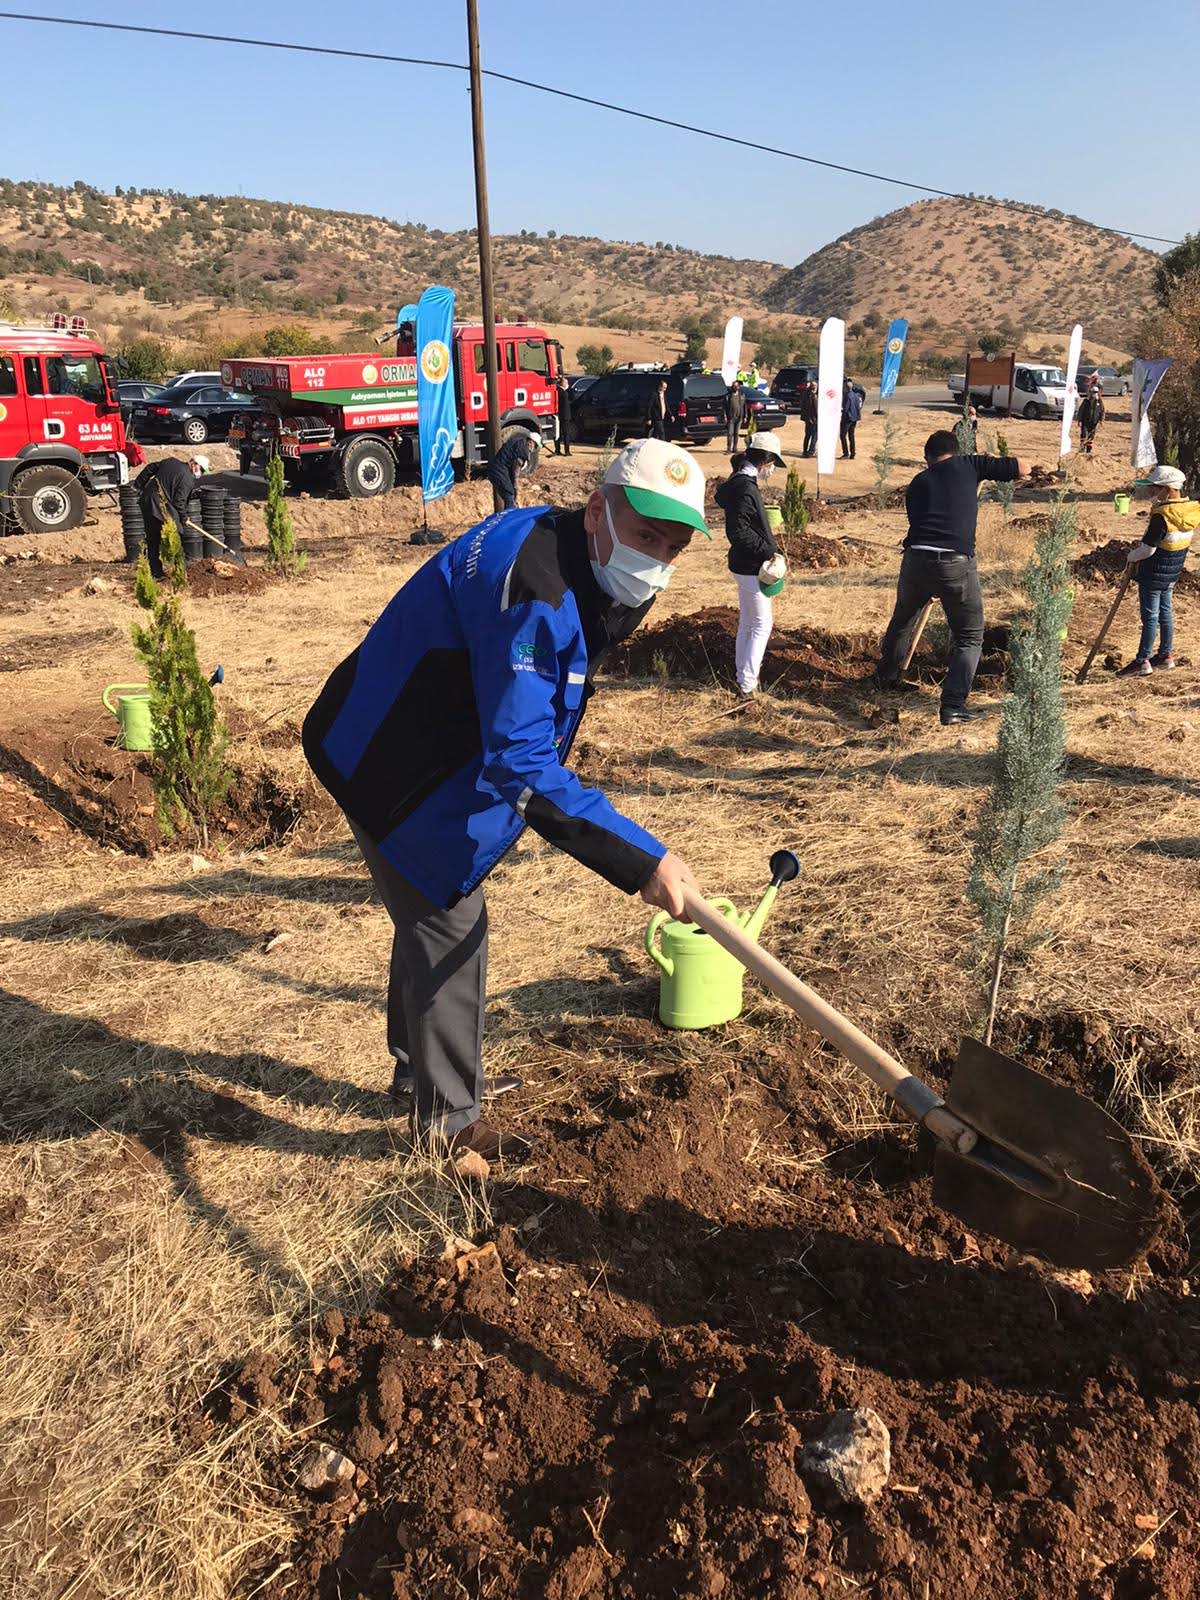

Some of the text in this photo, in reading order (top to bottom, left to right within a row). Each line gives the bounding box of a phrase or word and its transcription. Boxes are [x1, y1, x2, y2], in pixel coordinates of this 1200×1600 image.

[241, 366, 273, 386] ORMAN
[276, 366, 288, 378] ALO
[304, 367, 326, 378] ALO
[381, 365, 418, 383] ORMA
[277, 378, 289, 389] 177
[306, 378, 325, 388] 112
[352, 415, 365, 425] ALO
[366, 414, 377, 424] 177
[78, 422, 113, 434] 63 A 04
